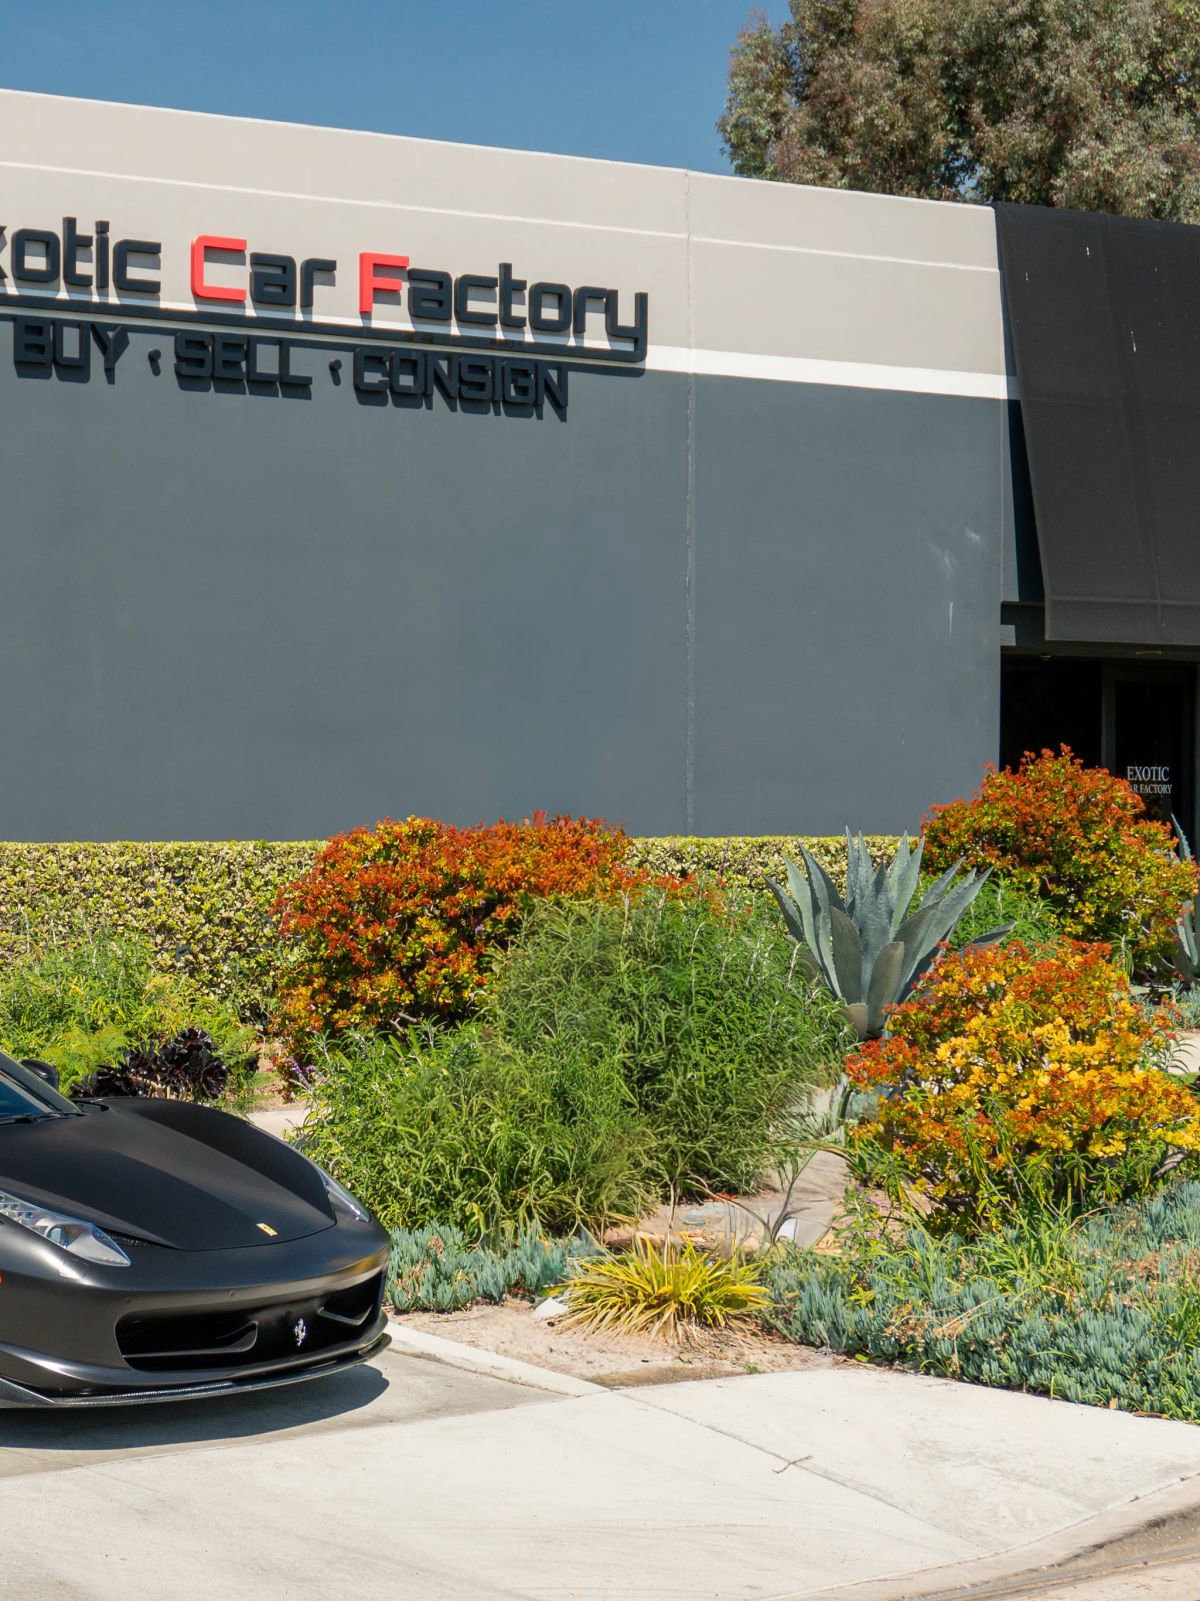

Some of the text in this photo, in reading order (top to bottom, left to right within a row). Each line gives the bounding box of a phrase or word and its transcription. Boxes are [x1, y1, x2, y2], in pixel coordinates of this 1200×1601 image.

[190, 234, 337, 308] Car
[358, 251, 649, 362] Factory
[13, 317, 569, 408] BUY SELL CONSIGN
[1126, 766, 1170, 782] EXOTIC
[1139, 783, 1173, 794] FACTORY
